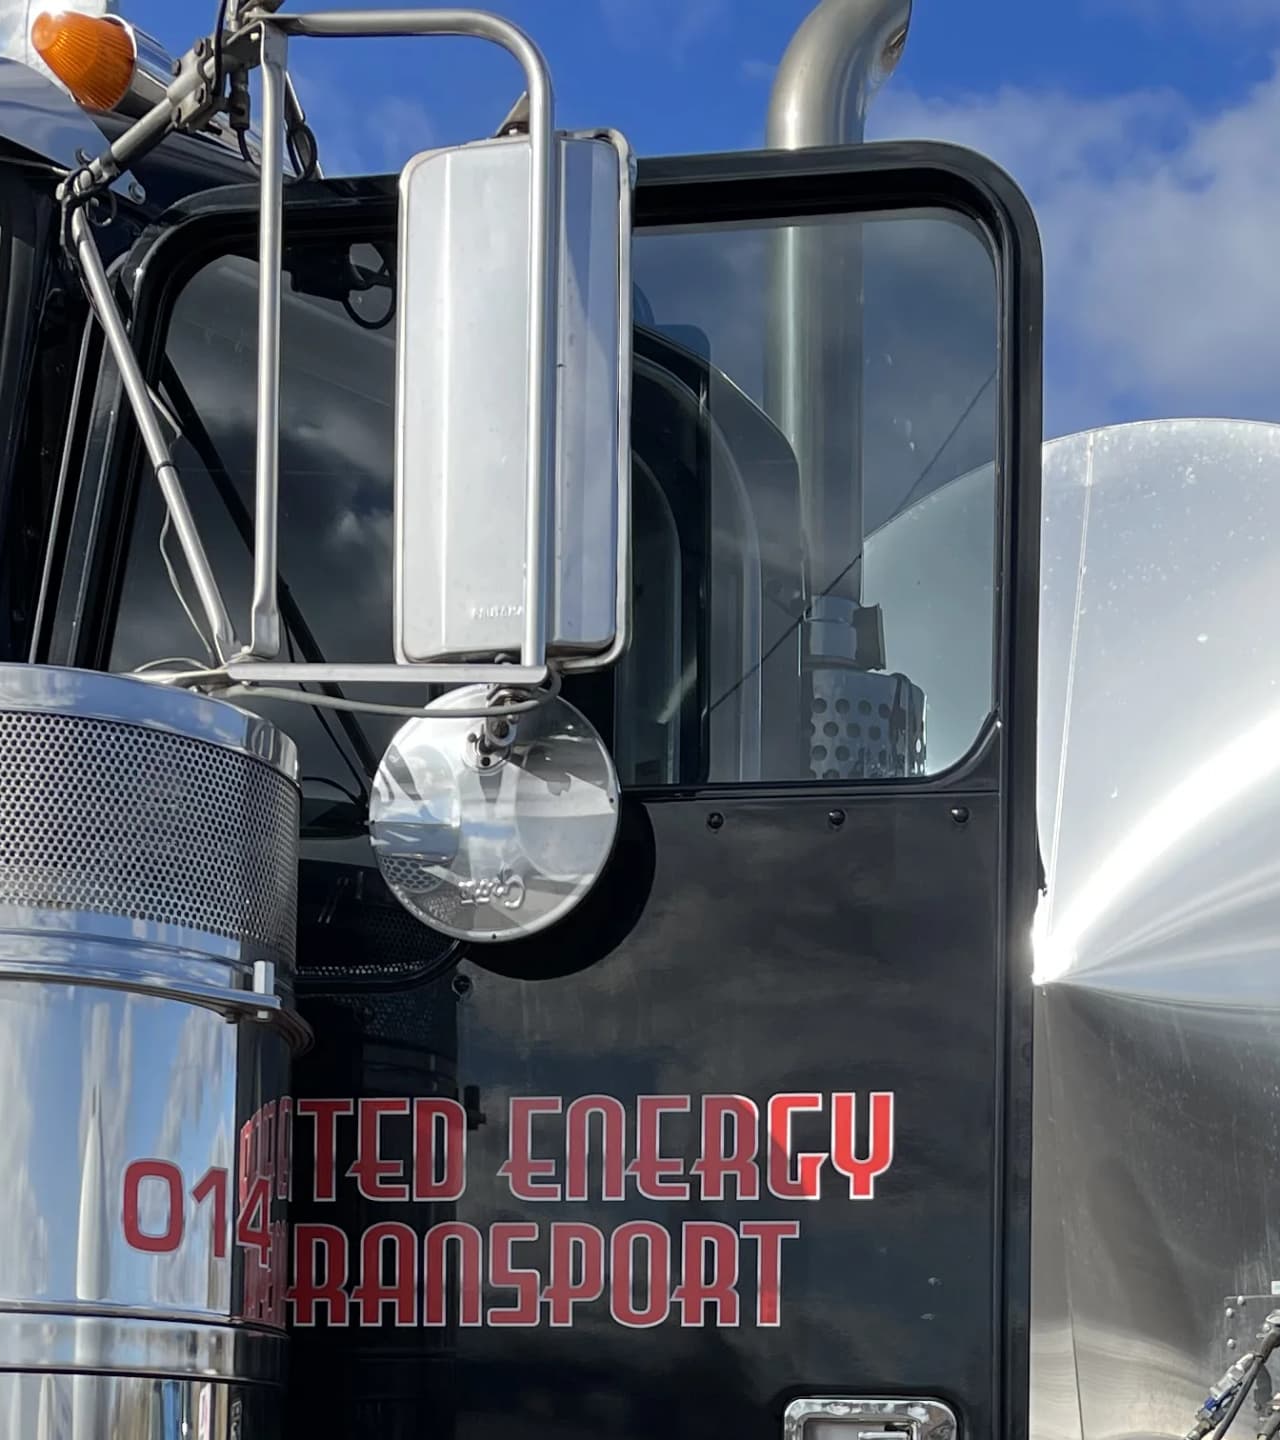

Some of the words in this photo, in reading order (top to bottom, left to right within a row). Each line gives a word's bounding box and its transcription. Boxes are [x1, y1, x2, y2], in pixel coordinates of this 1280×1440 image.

[296, 1095, 466, 1203] TED
[497, 1090, 895, 1202] ENERGY
[120, 1158, 275, 1268] 014
[286, 1219, 801, 1329] RANSPORT
